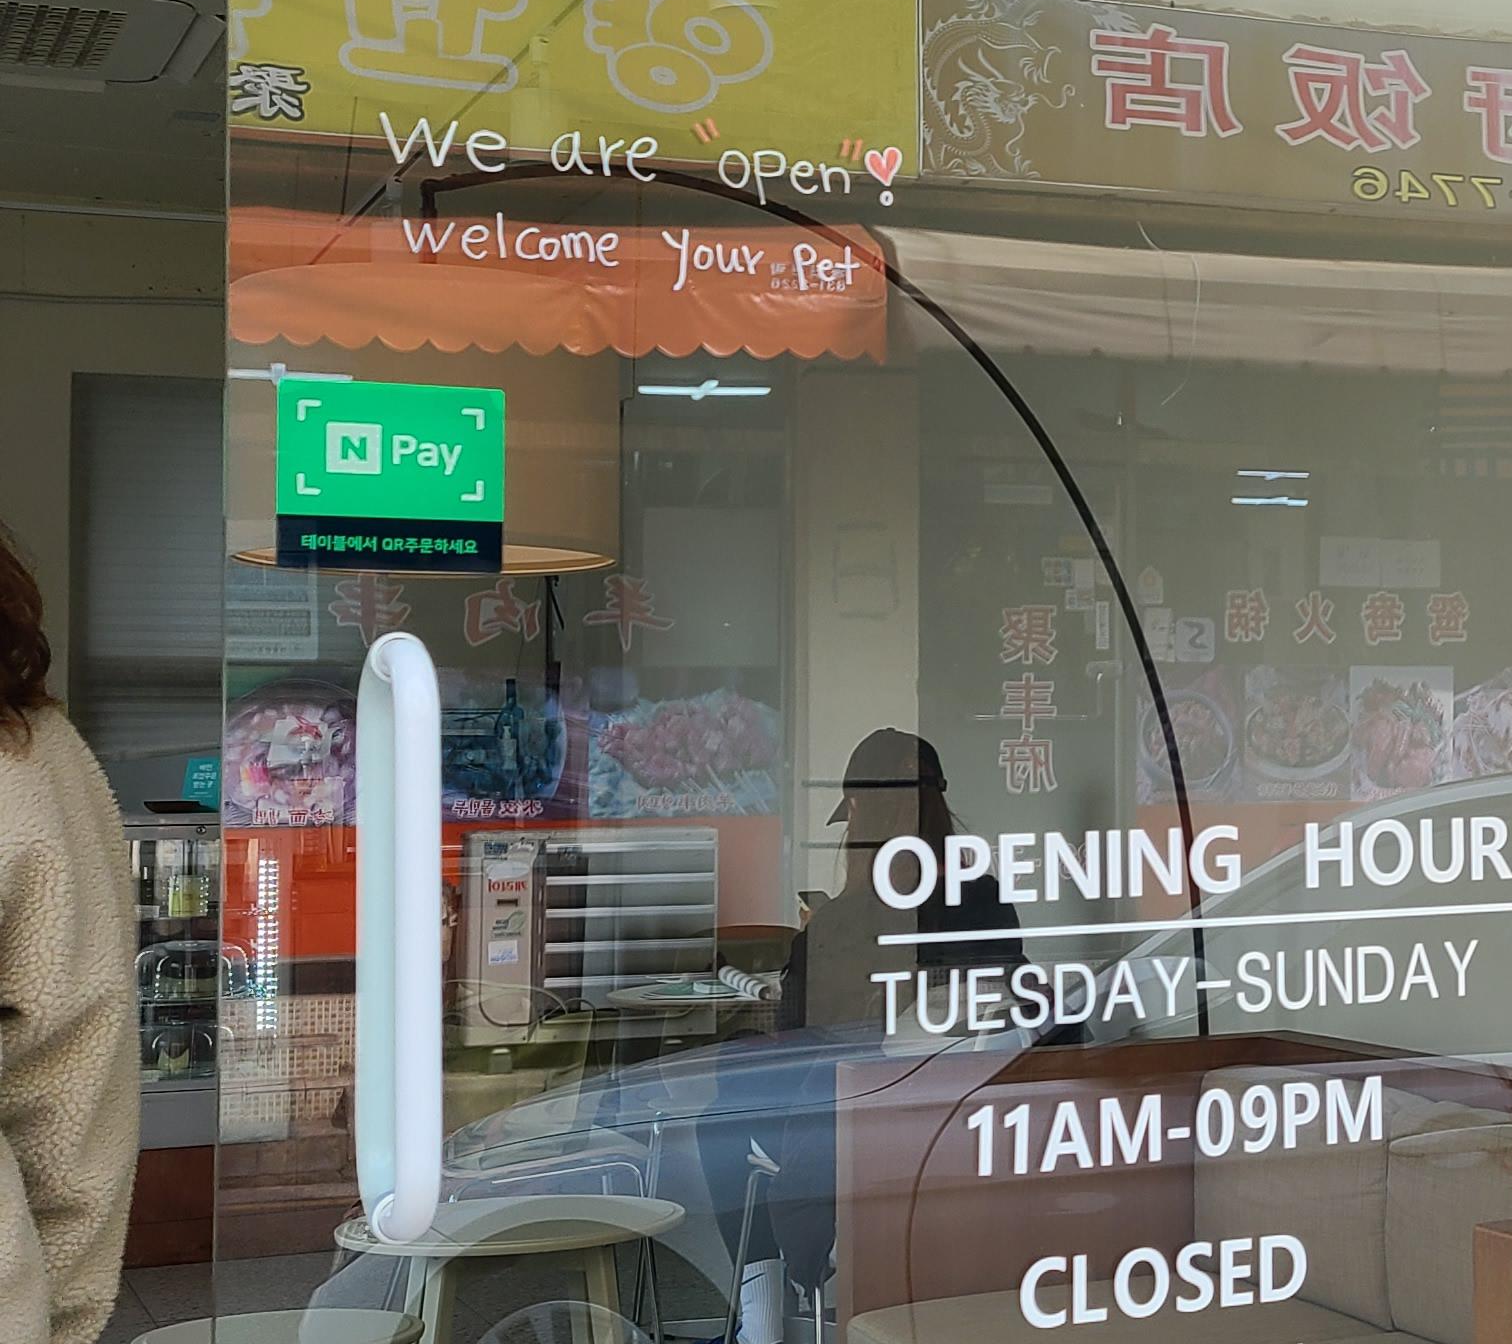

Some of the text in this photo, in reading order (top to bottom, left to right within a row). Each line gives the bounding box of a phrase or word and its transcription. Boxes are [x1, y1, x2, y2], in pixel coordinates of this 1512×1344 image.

[379, 111, 507, 174] We
[550, 130, 659, 182] are
[392, 434, 463, 476] Pay
[301, 534, 479, 555] 테이블에서 QR주문하세요
[871, 824, 1243, 910] OPENING
[869, 939, 1480, 1037] TUESDAY-SUNDAY
[966, 1075, 1386, 1178] 11AM-09PM
[1018, 1234, 1308, 1330] CLOSED
